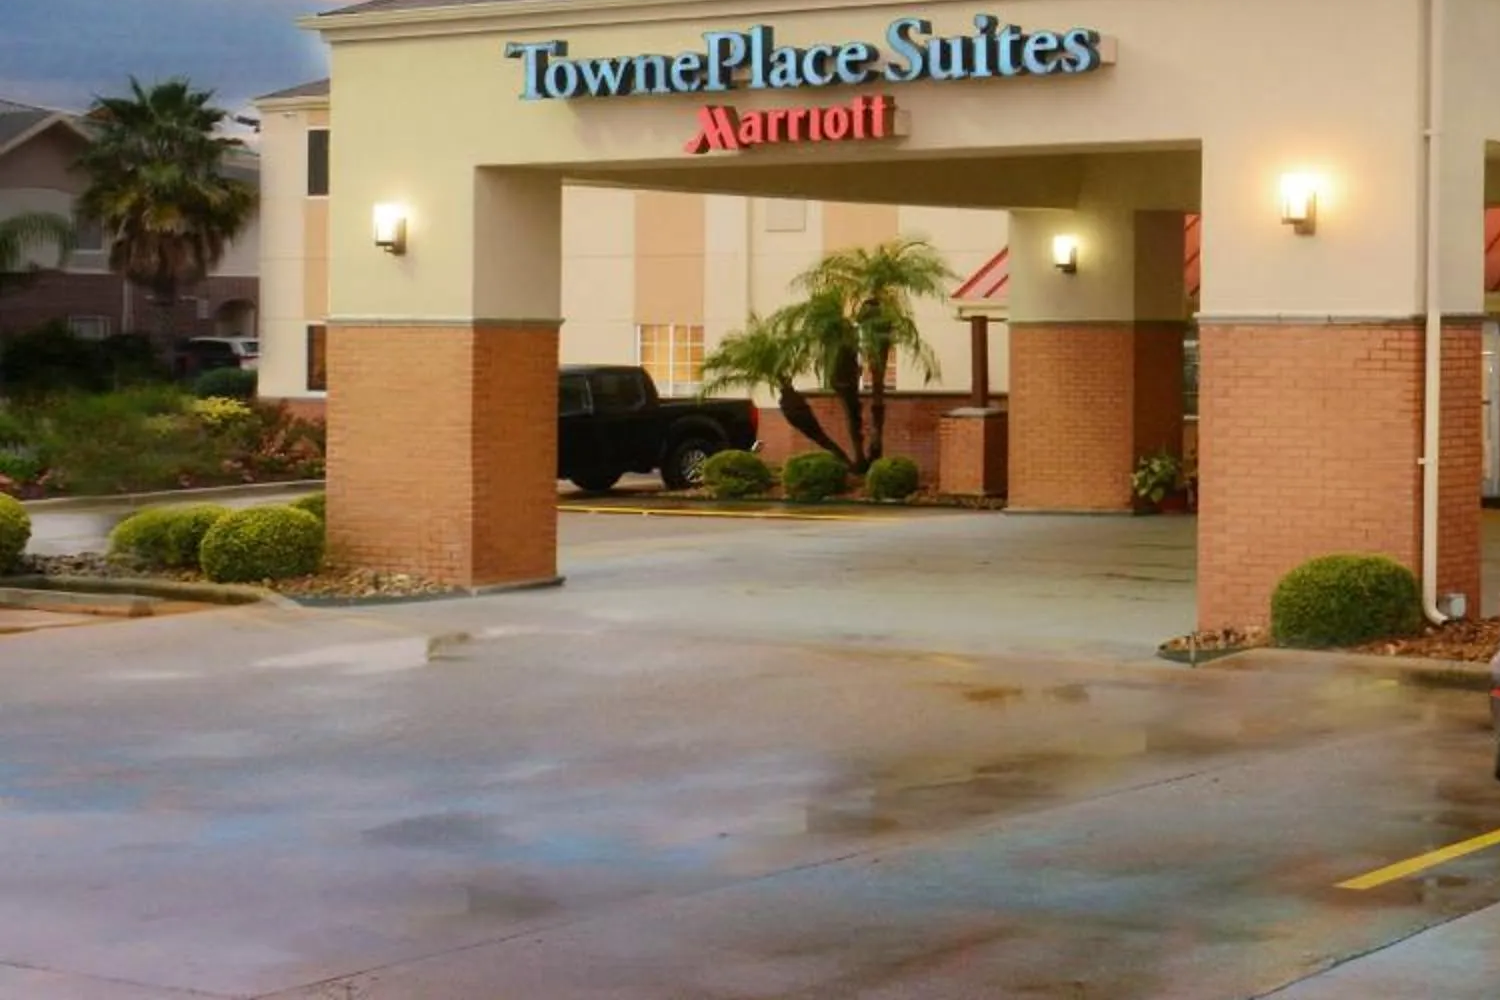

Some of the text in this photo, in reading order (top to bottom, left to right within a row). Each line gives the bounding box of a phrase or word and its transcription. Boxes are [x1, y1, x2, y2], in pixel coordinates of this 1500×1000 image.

[505, 14, 1099, 101] TownePlace Suites
[684, 94, 893, 155] Marriott
